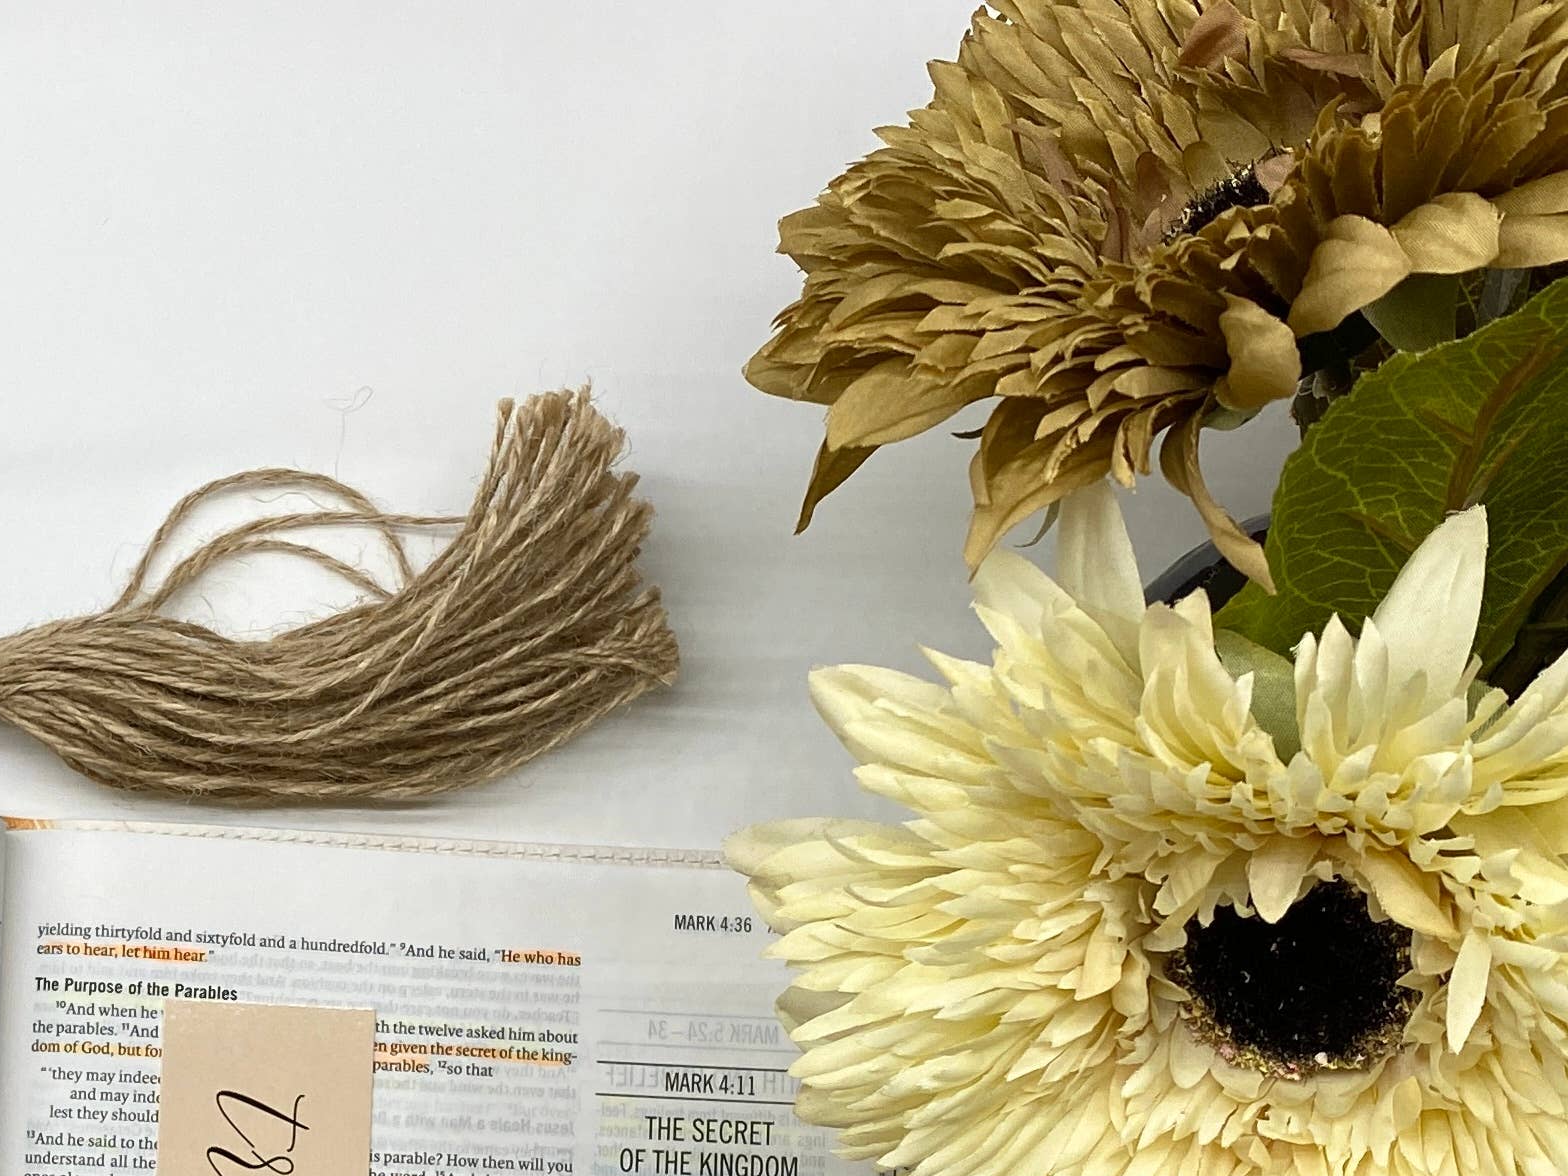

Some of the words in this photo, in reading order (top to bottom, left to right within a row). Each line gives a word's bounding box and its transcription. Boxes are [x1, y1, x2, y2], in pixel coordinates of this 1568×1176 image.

[674, 914, 716, 932] MARK
[720, 916, 752, 933] 4:36
[36, 944, 64, 955] ears
[66, 944, 81, 955] to
[83, 942, 118, 959] hear,
[121, 944, 141, 959] let
[142, 945, 170, 960] him
[174, 947, 215, 963] hear.”
[34, 976, 60, 992] The
[64, 977, 123, 996] Purpose
[128, 980, 143, 995] of
[146, 981, 170, 997] the
[174, 983, 238, 1001] Parables
[665, 1071, 714, 1094] MARK
[718, 1074, 756, 1096] 4:11
[644, 1115, 685, 1142] THE
[692, 1117, 775, 1146] SECRET
[619, 1147, 647, 1174] OF
[651, 1149, 692, 1176] THE
